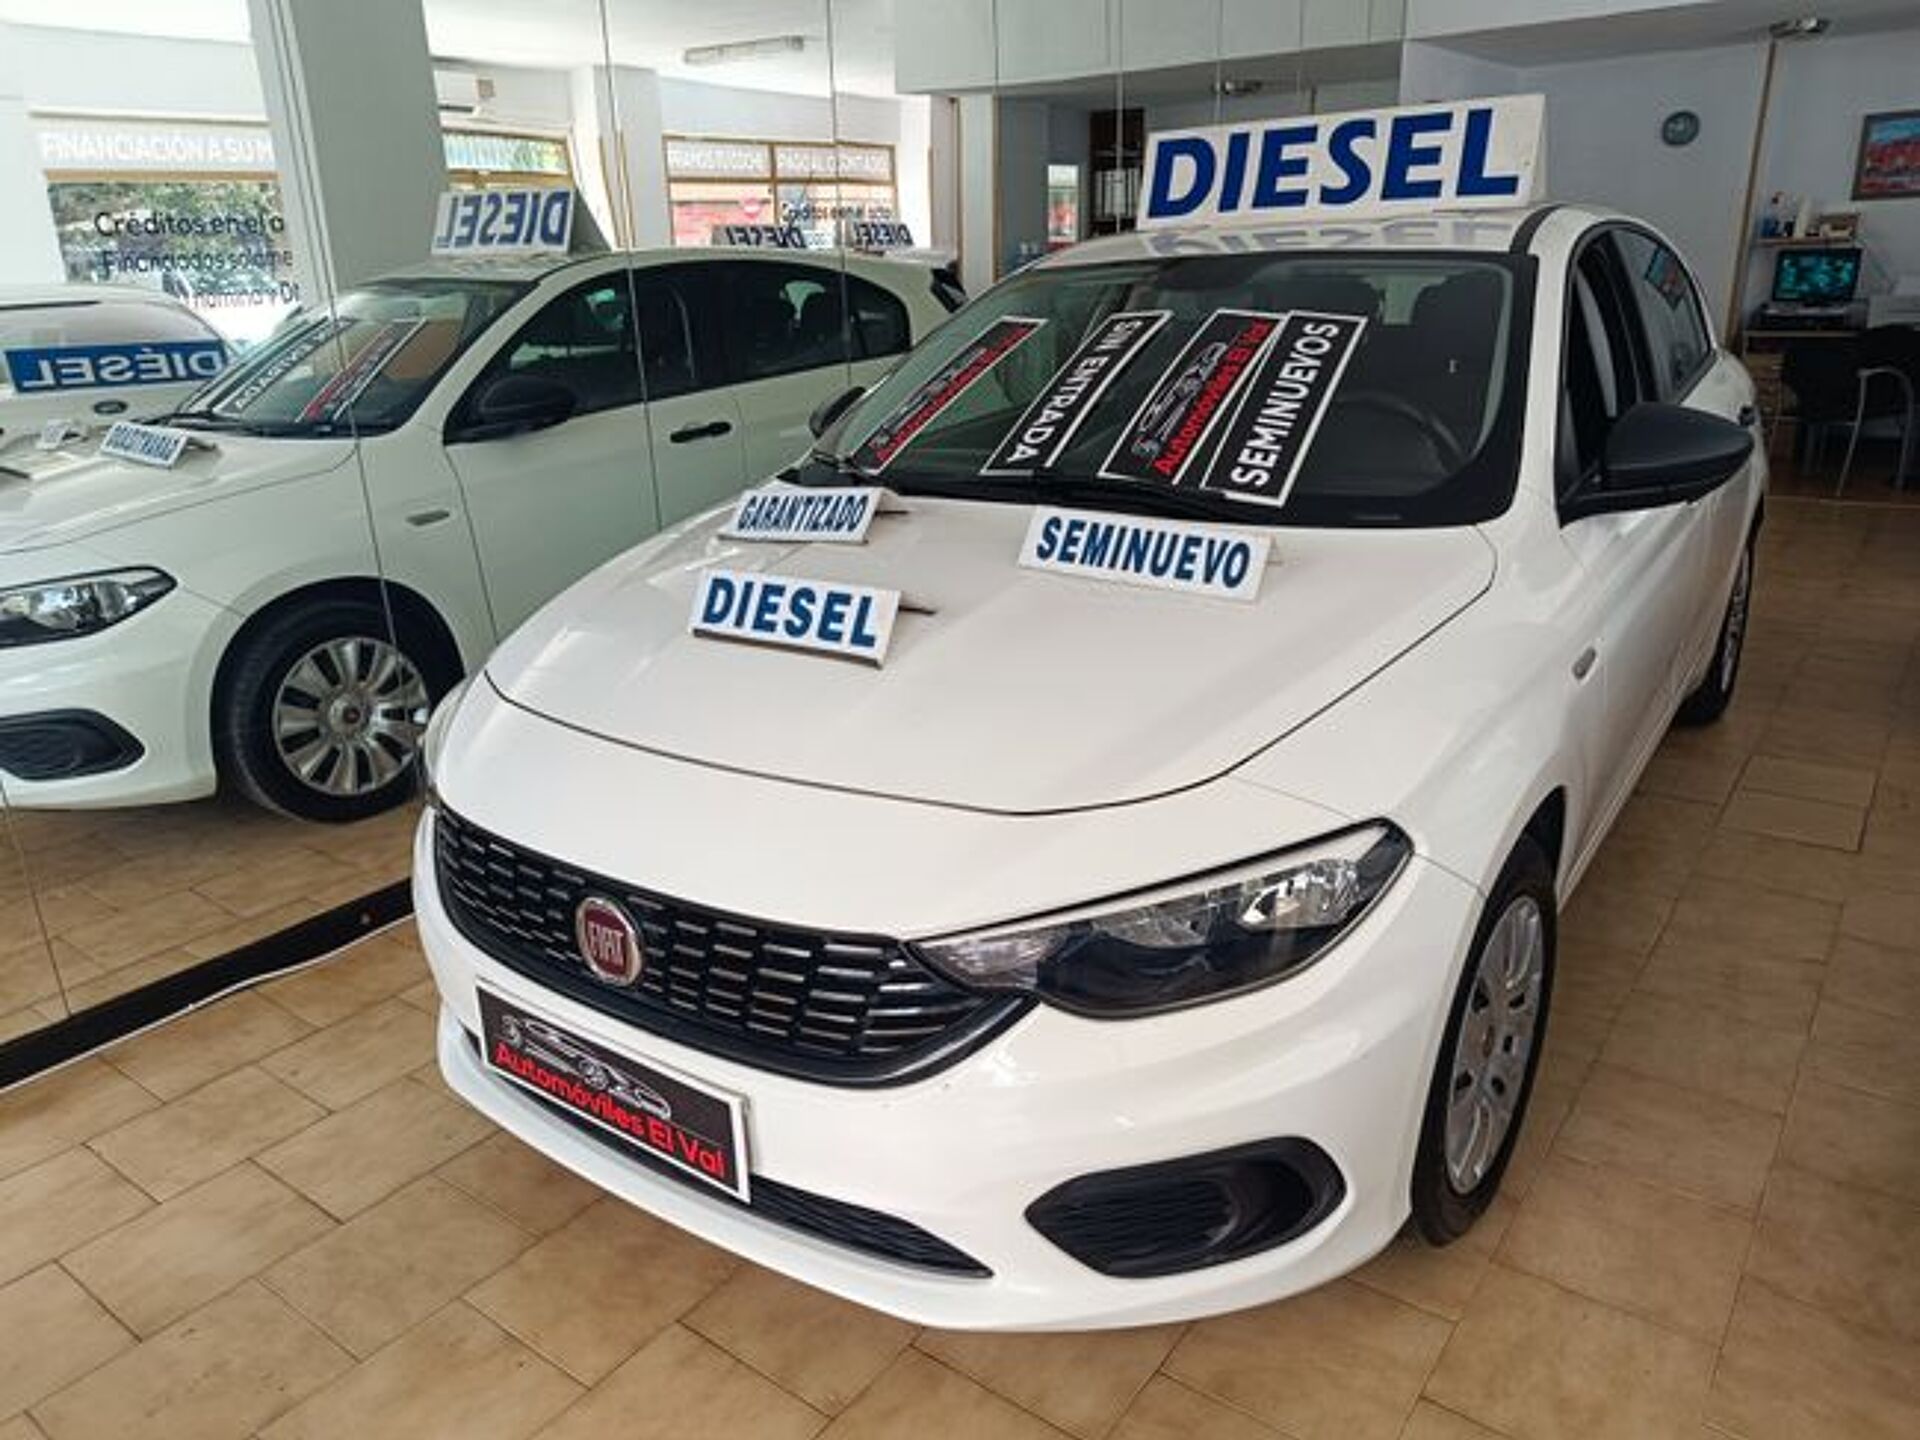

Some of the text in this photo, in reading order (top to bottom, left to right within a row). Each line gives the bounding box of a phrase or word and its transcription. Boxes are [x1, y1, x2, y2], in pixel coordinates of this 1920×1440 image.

[1147, 107, 1521, 219] DIESEL
[1006, 356, 1111, 463] ENTRADA
[1230, 322, 1340, 487] SEMINUEVOS
[736, 491, 870, 532] GARANTIZADO
[1035, 516, 1252, 589] SEMINUEVO
[701, 576, 877, 649] DIESEL
[587, 920, 625, 967] FIAT
[495, 1041, 726, 1179] Automóviles El Val
